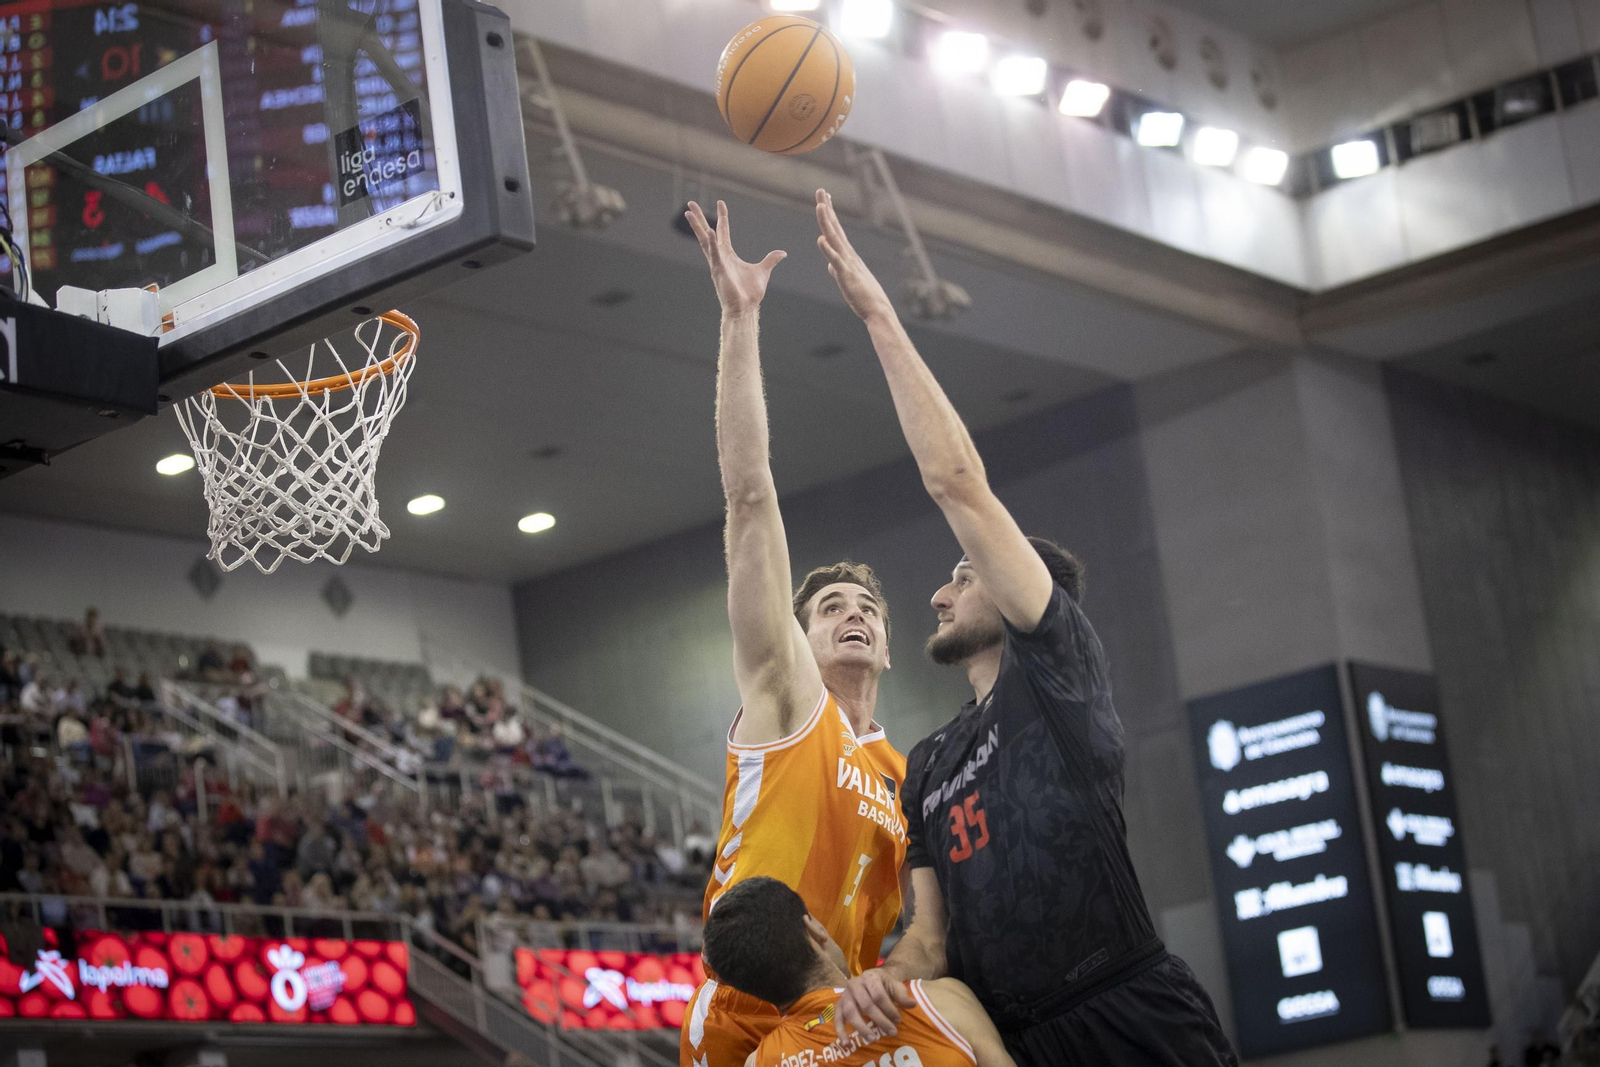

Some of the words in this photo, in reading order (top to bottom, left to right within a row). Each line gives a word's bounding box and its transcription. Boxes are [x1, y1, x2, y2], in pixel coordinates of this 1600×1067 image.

[340, 143, 376, 175] liga
[343, 149, 421, 196] endesa
[948, 790, 990, 863] 35
[78, 958, 169, 994] lapalma
